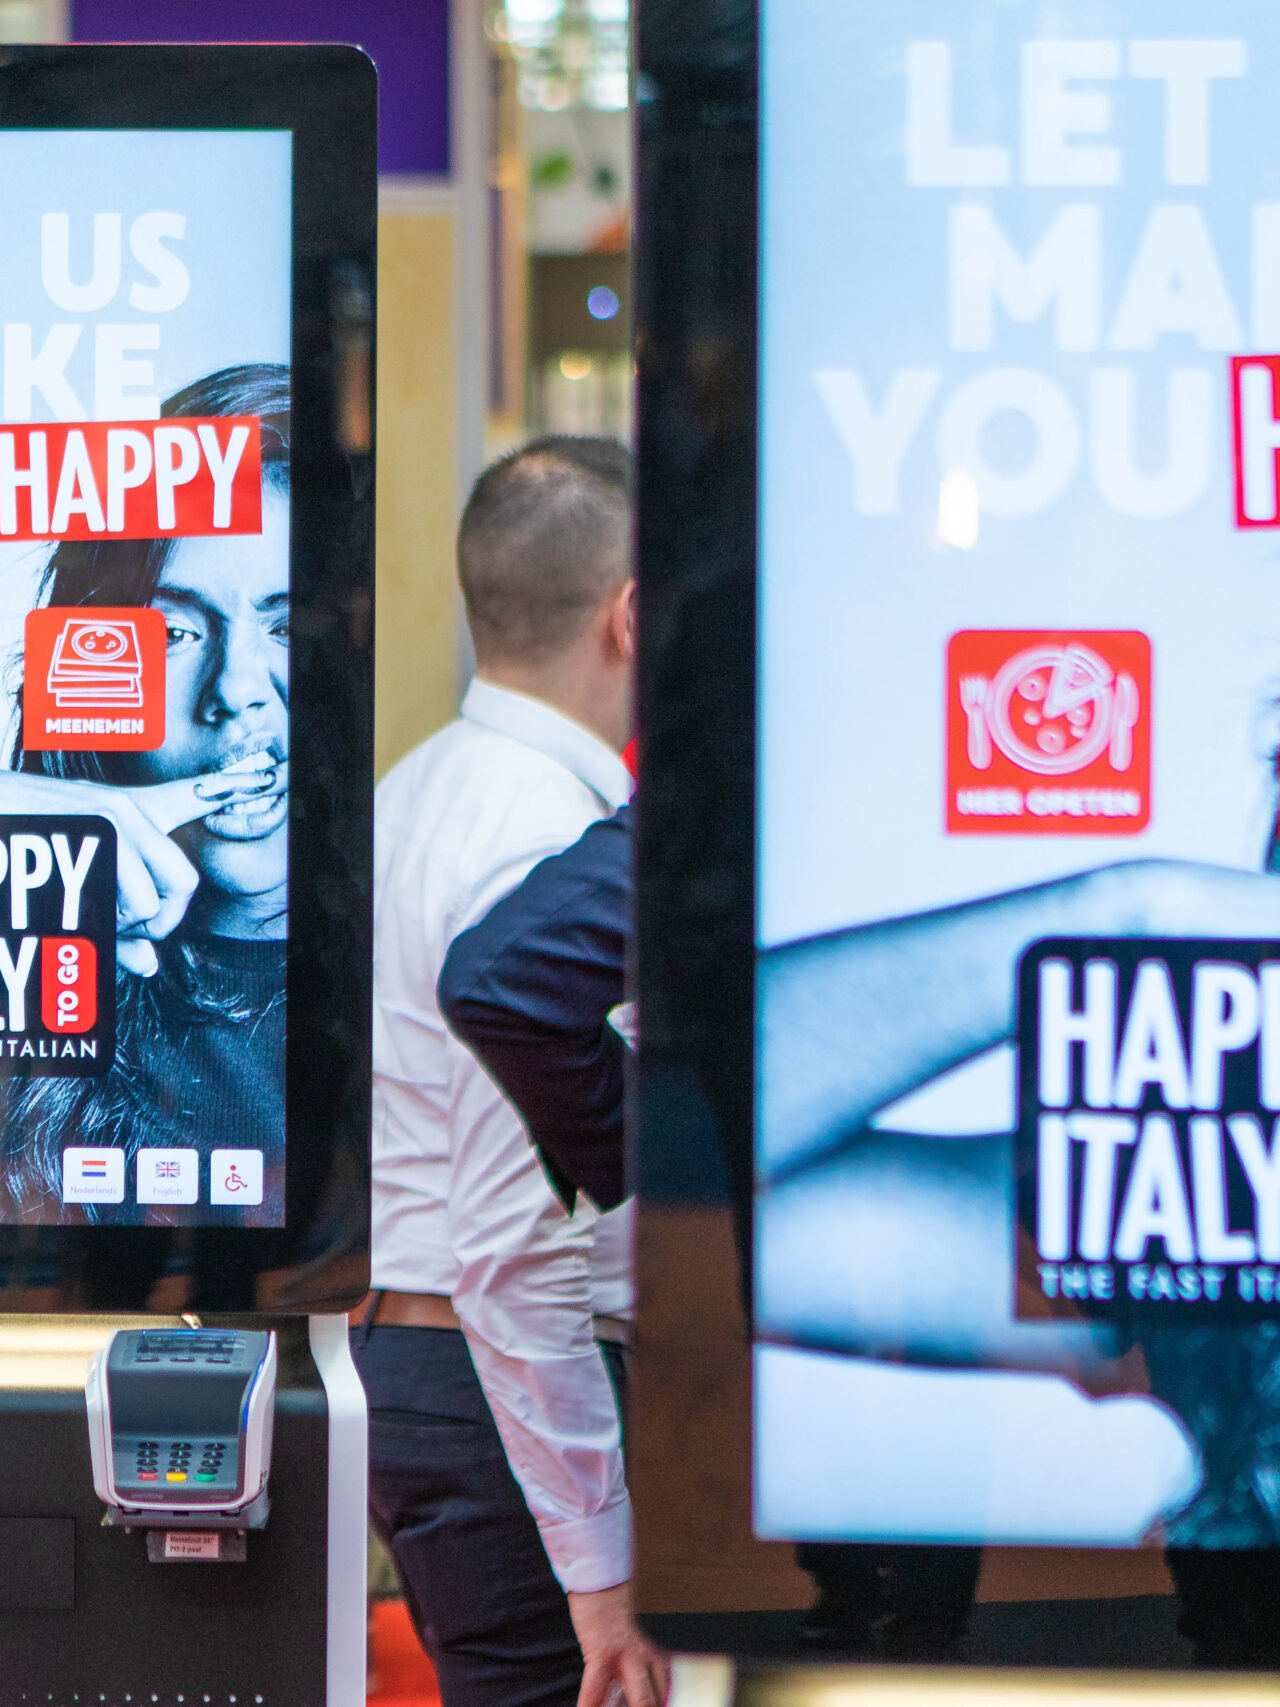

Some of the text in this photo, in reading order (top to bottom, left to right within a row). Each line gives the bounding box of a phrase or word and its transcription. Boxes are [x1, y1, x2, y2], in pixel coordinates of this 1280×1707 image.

[905, 39, 1247, 187] LET
[41, 211, 191, 312] US
[948, 203, 1280, 352] MA
[811, 366, 1213, 518] YOU
[45, 718, 144, 734] MEENEMEN
[57, 944, 79, 1027] TO GO
[70, 1186, 118, 1195] Nederlands
[152, 1187, 182, 1197] English
[1037, 1263, 1115, 1300] THE
[1127, 1264, 1226, 1302] FAST
